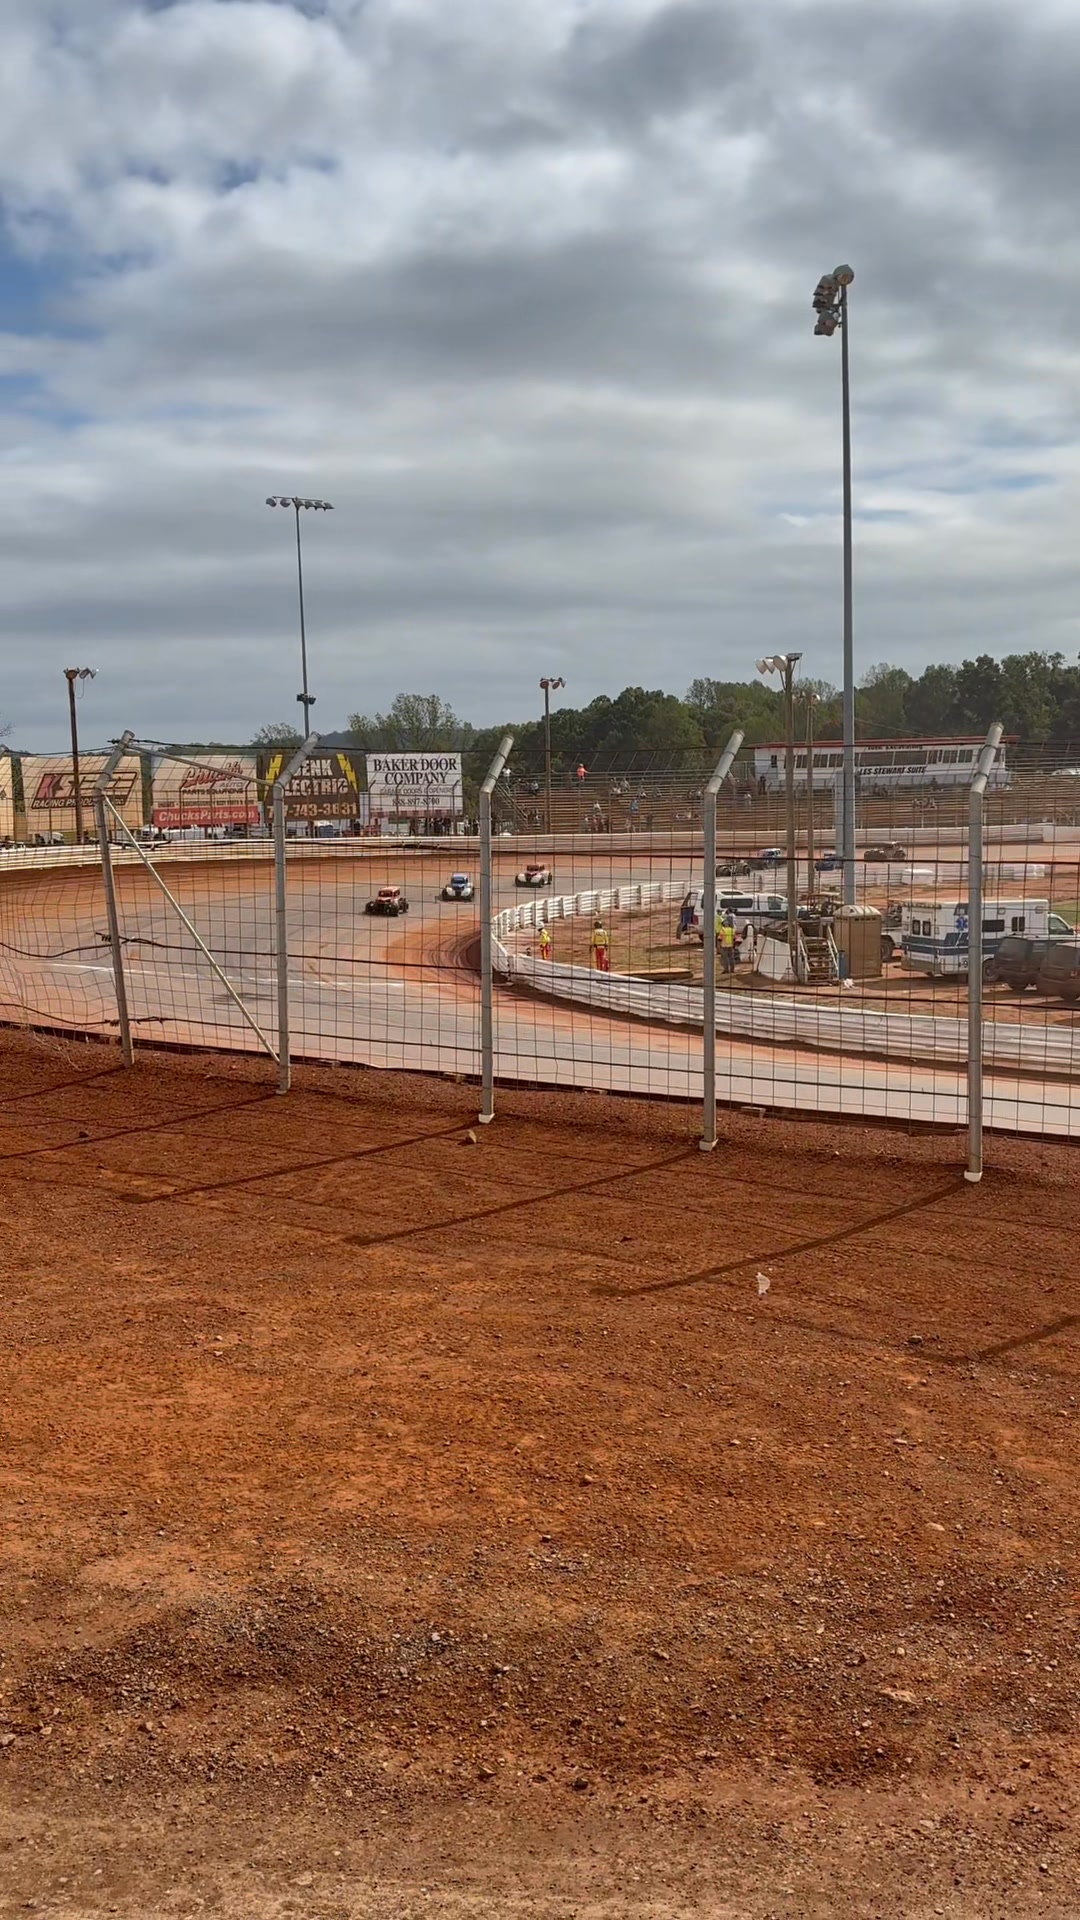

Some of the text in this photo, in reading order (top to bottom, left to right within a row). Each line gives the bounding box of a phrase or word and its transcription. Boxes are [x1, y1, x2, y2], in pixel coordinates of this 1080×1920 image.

[373, 758, 457, 771] BAKER DOOR
[859, 766, 927, 776] LES STEWART SUITE
[384, 772, 447, 785] COMPANY
[284, 778, 349, 796] LECTRIC
[159, 809, 255, 821] ChucksParts.com
[267, 802, 357, 818] 77-743-3631
